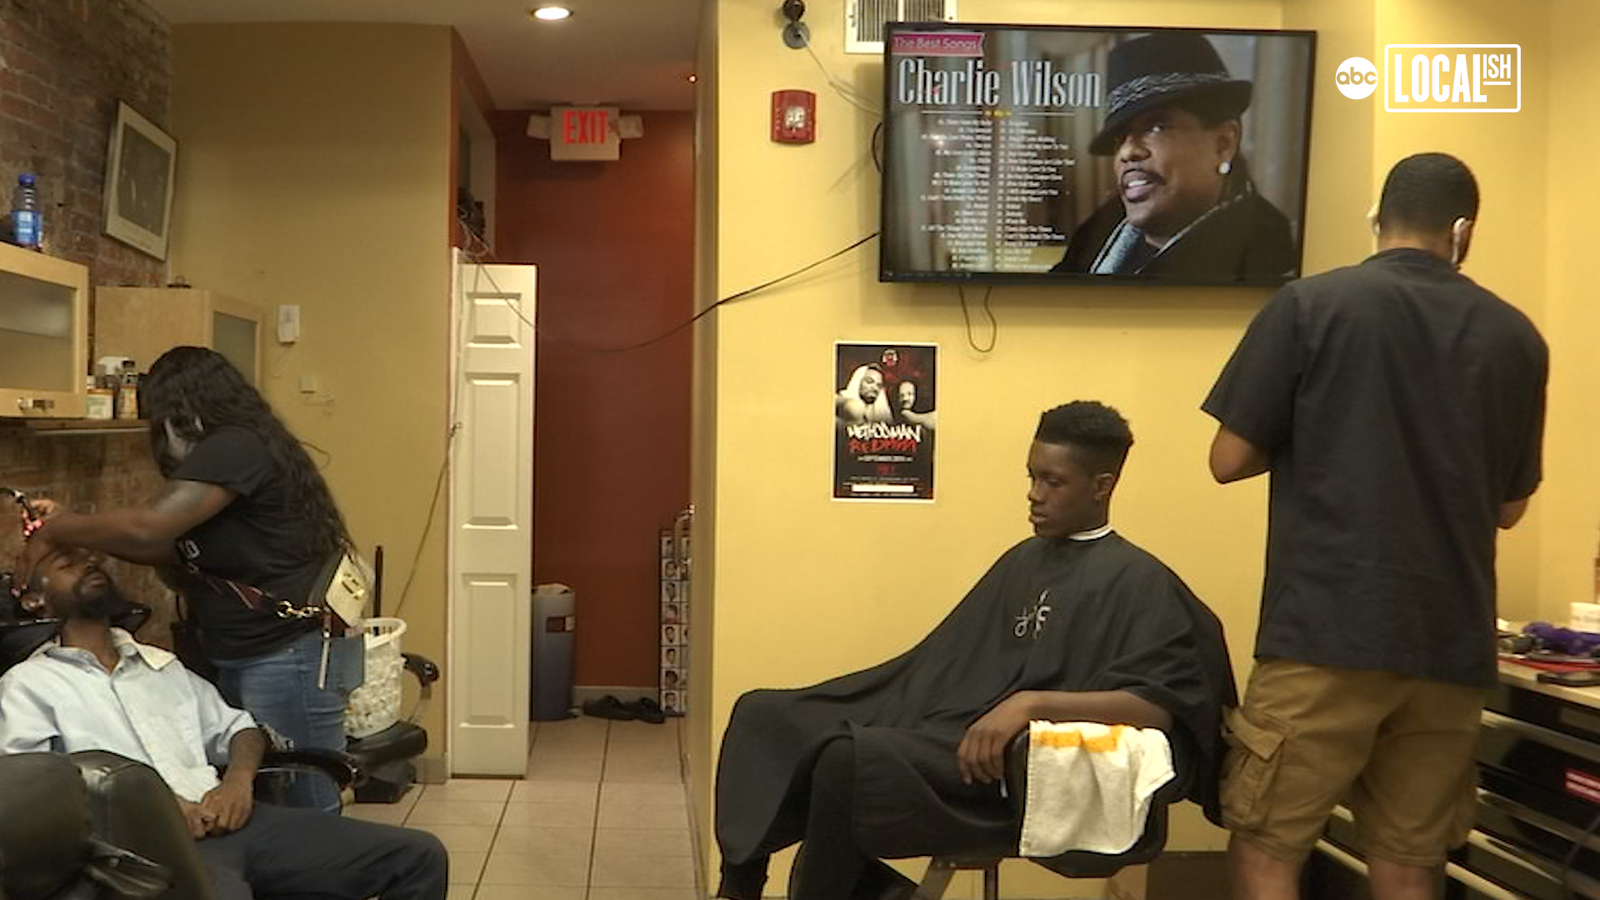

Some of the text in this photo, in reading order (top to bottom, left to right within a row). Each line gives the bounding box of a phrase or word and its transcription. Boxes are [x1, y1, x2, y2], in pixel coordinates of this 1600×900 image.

[916, 37, 941, 48] Best
[942, 38, 978, 51] Songs
[899, 58, 1100, 107] Charlie Wilson
[564, 110, 608, 144] EXIT
